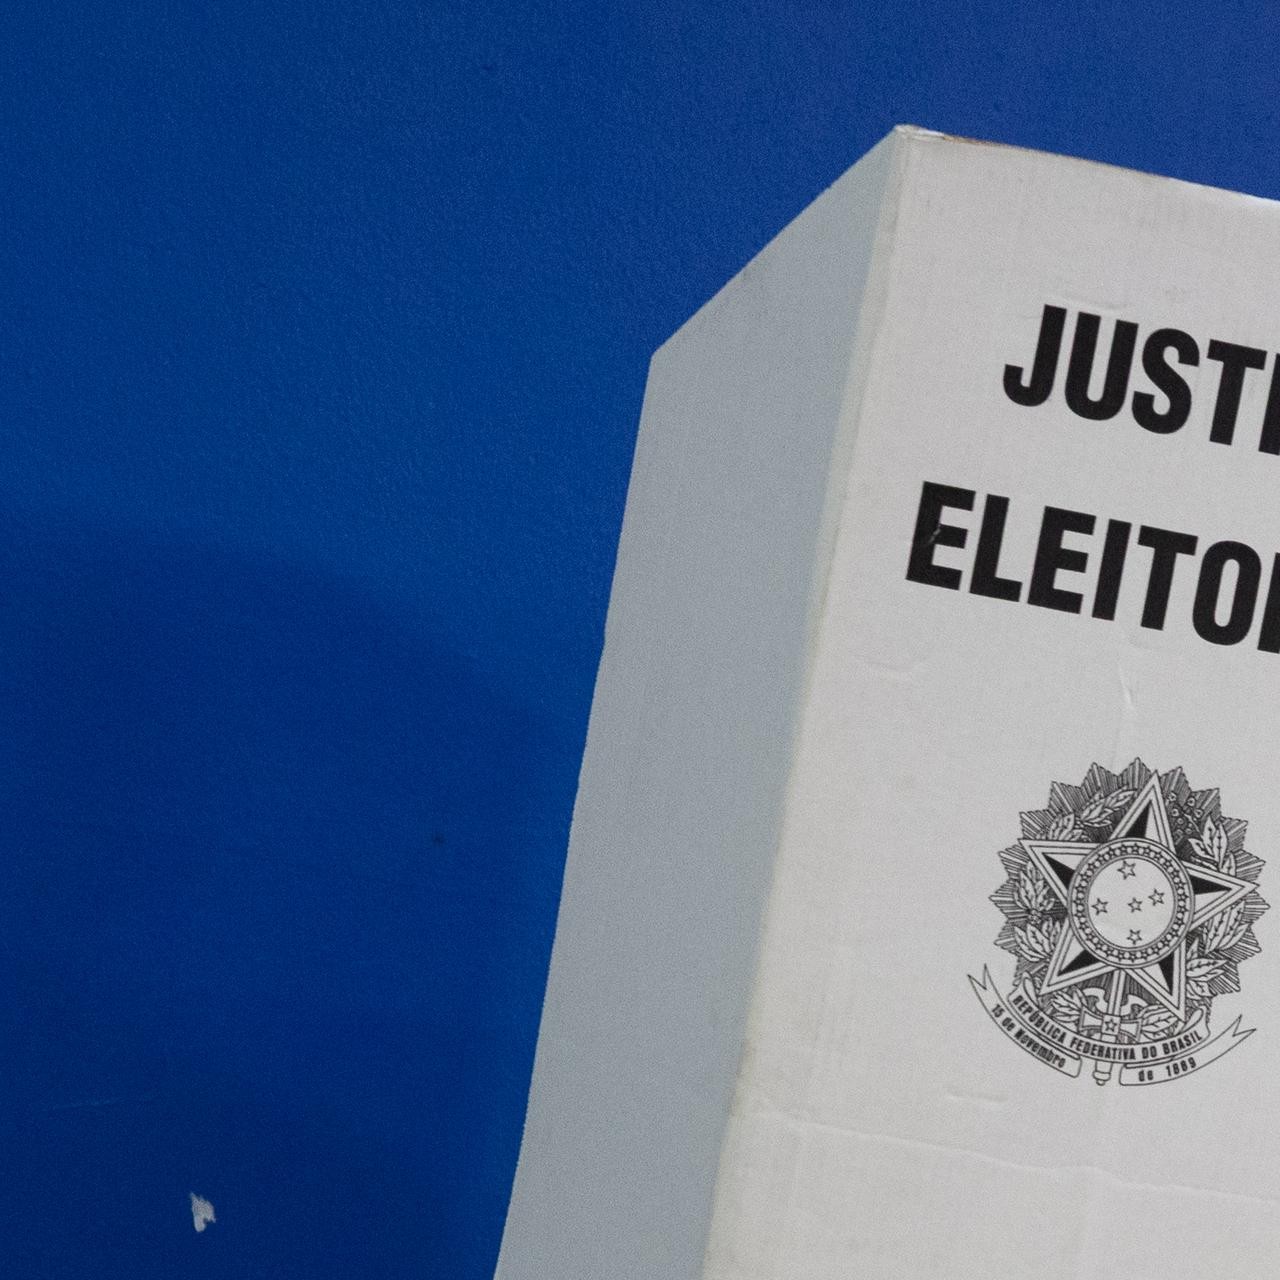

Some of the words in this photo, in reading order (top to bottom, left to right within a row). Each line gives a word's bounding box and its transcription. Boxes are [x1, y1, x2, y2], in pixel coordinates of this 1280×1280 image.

[992, 1003, 1005, 1018] 15
[1166, 1057, 1197, 1077] 1889
[1070, 1037, 1136, 1060] FEDERATIVA
[1141, 1046, 1157, 1059] DO
[1162, 1030, 1203, 1054] BRASIL
